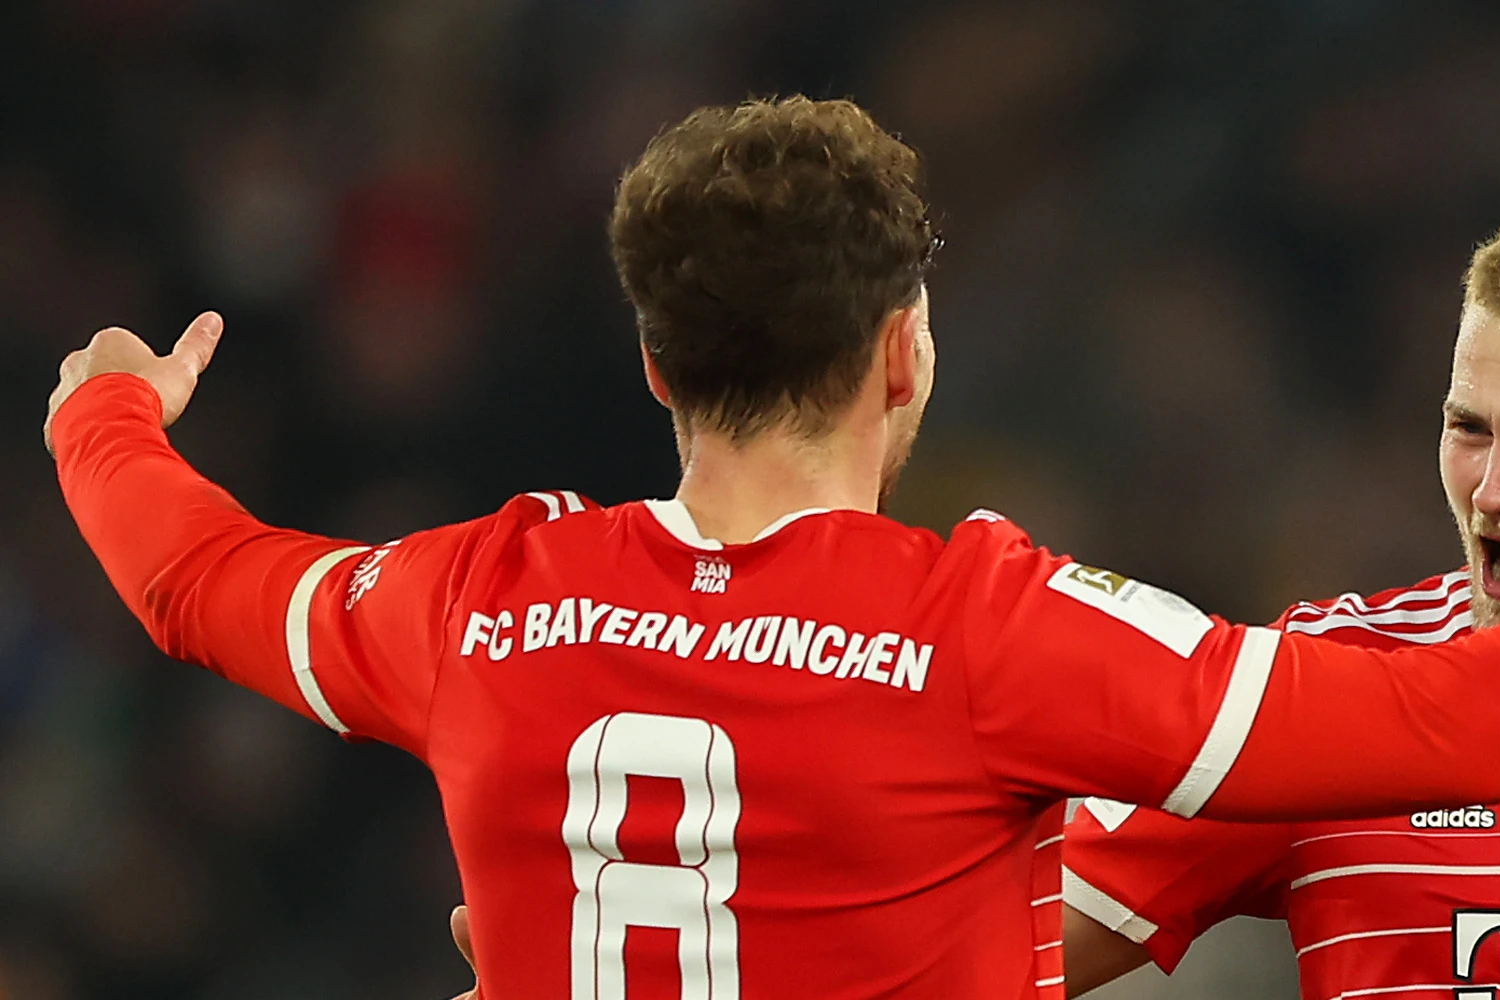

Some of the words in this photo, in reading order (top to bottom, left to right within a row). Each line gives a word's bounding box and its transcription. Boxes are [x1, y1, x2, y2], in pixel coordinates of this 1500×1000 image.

[694, 561, 731, 580] SAN
[690, 577, 726, 594] MIA
[460, 610, 514, 661] FC
[523, 598, 706, 659] BAYERN
[703, 616, 934, 692] MÜNCHEN
[1411, 806, 1496, 828] adidas
